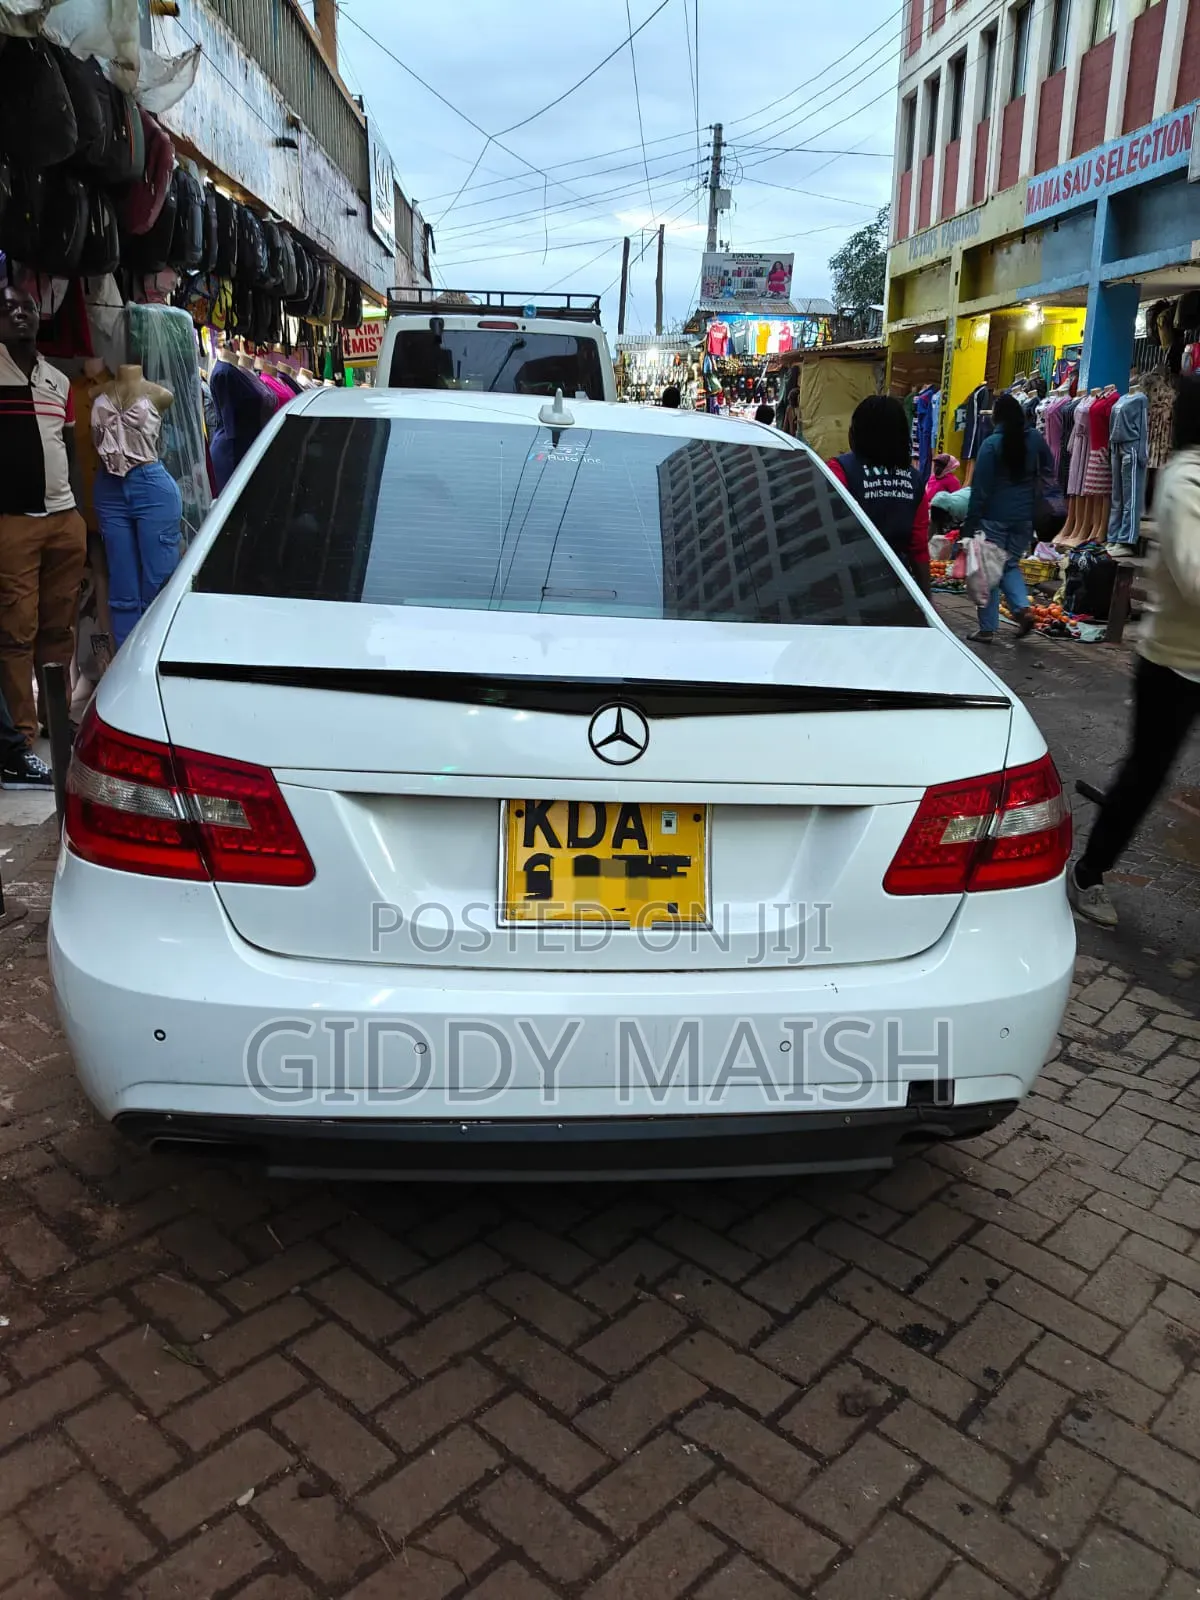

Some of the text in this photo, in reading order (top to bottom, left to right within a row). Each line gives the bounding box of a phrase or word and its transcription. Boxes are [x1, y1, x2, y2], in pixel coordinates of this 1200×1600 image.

[1026, 177, 1061, 216] MAMA
[1063, 160, 1092, 200] SAU
[863, 479, 882, 489] Bank
[523, 800, 648, 850] KDA
